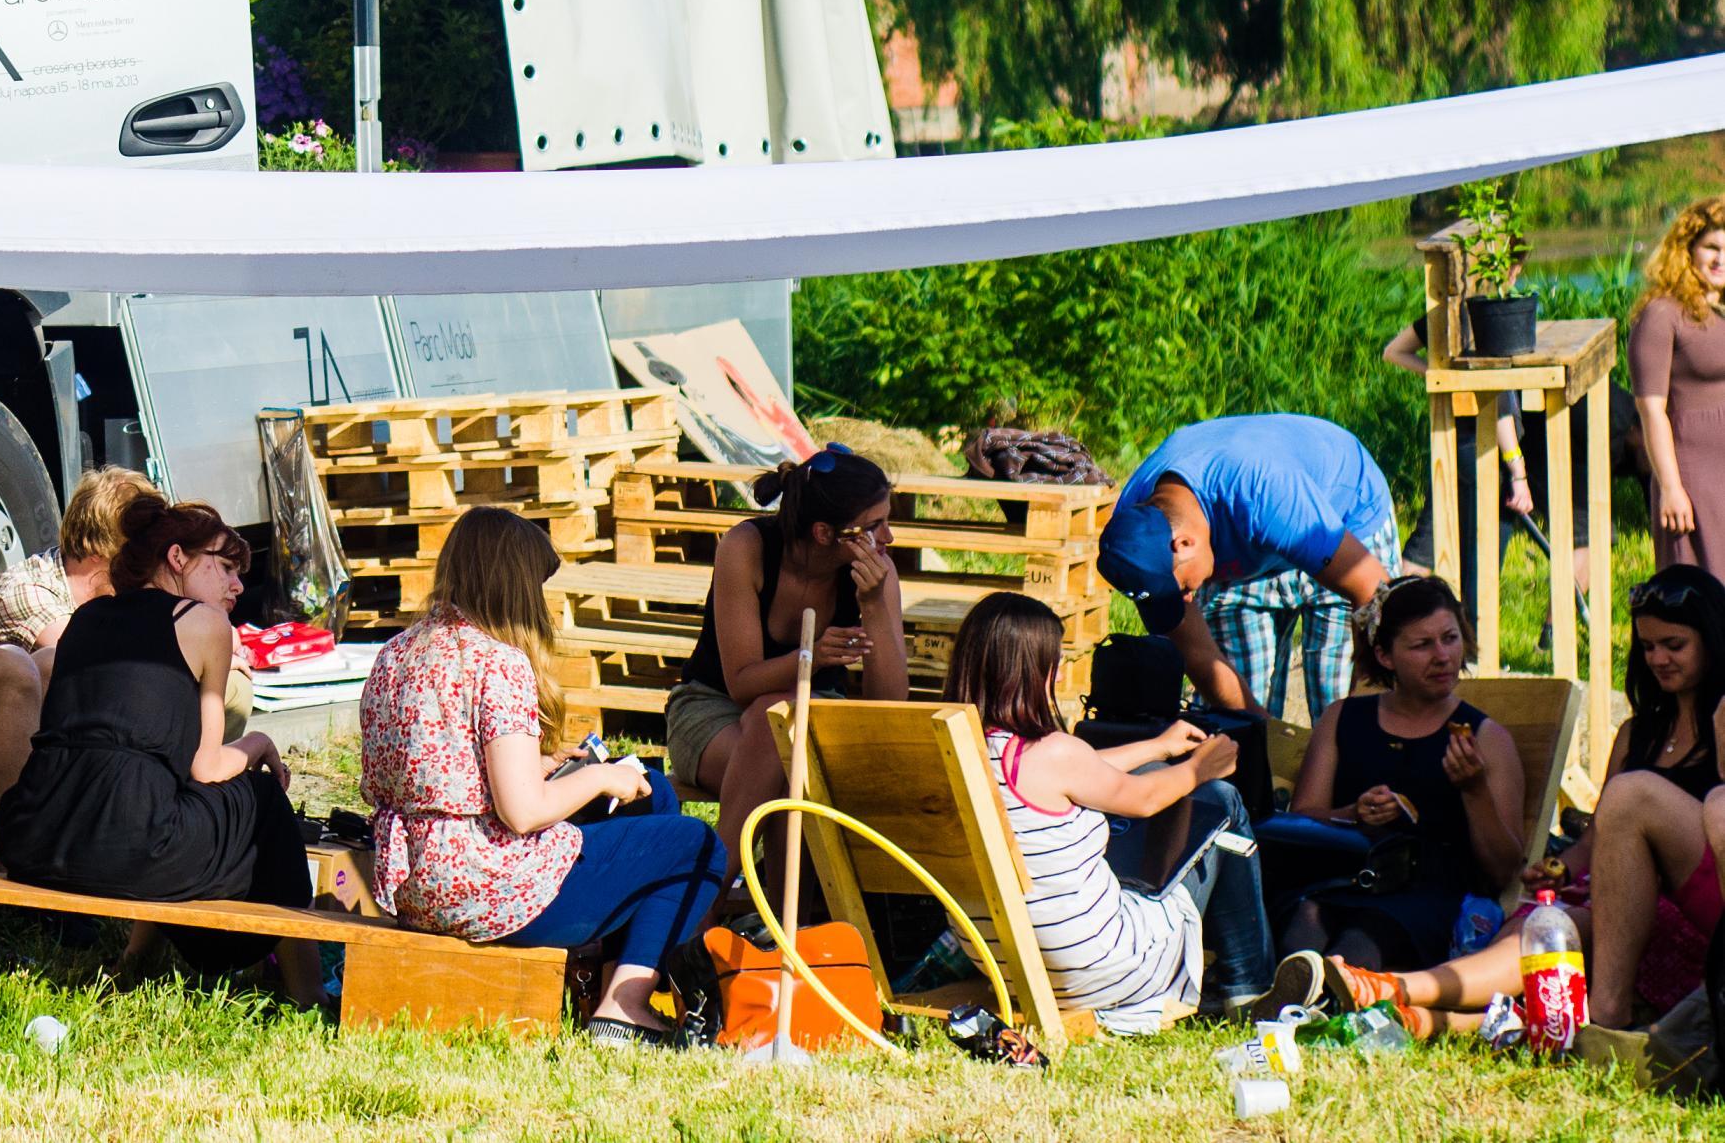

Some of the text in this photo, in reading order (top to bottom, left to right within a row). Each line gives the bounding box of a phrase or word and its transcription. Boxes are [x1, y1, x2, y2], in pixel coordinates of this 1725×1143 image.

[32, 56, 136, 75] crossing borders
[14, 85, 56, 99] napoca
[57, 80, 68, 92] 15
[91, 77, 114, 89] mai
[116, 74, 139, 88] 2013
[409, 319, 477, 362] Parc Mobil
